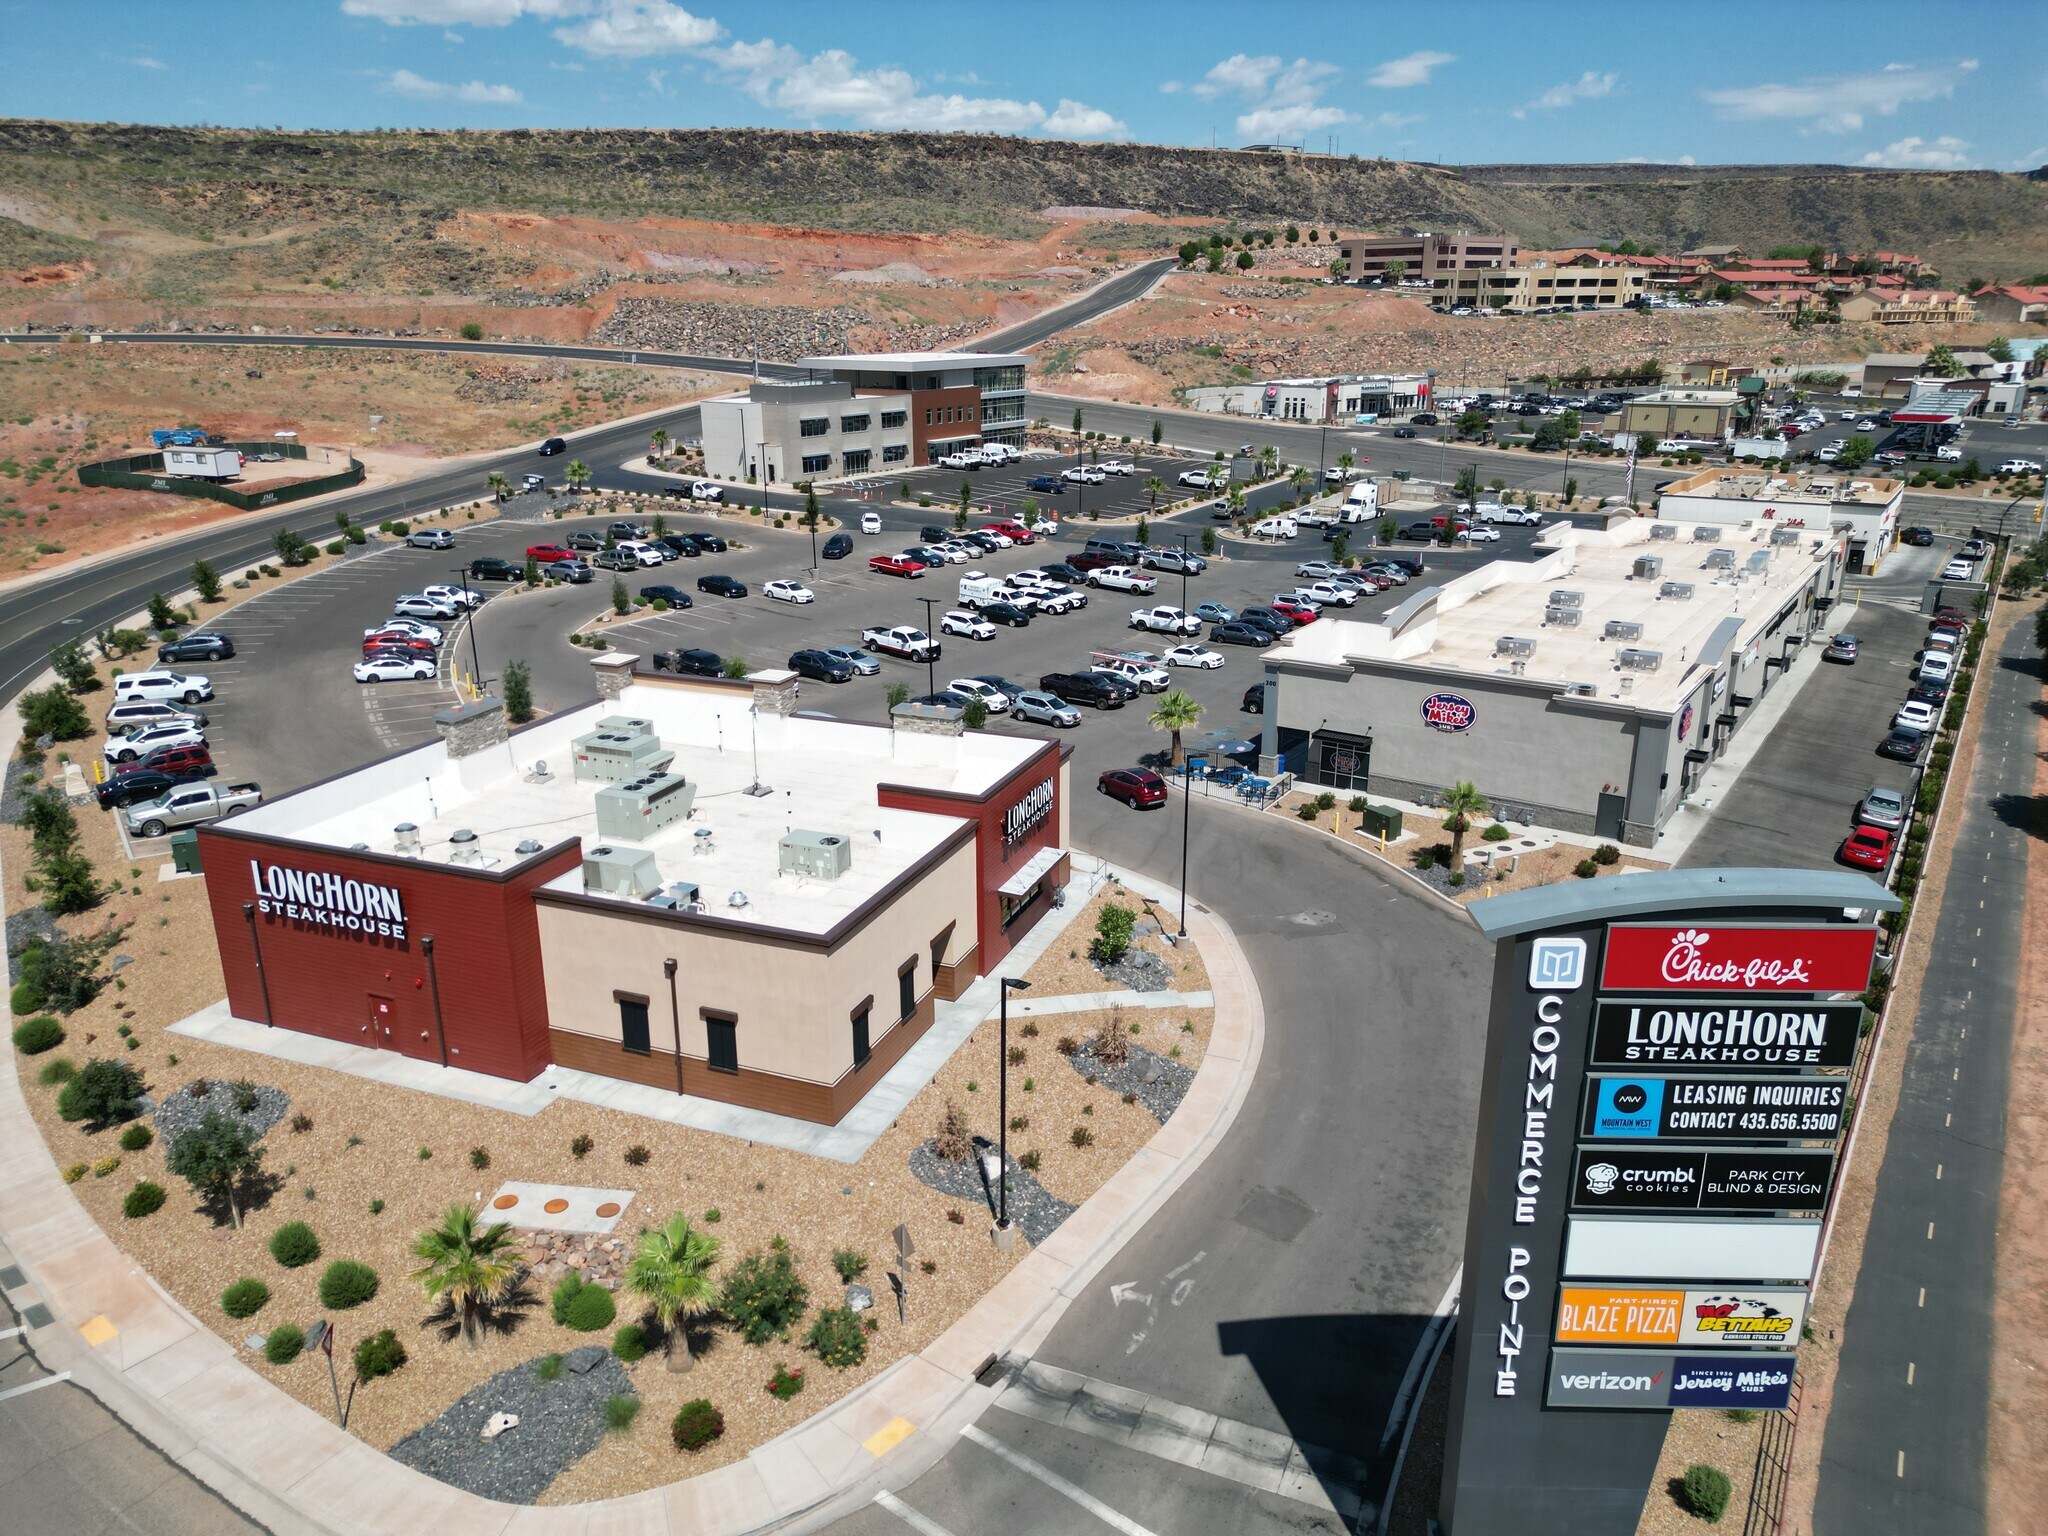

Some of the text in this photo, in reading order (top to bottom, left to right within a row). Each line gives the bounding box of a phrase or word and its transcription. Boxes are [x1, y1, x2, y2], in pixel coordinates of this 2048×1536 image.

[1426, 697, 1471, 717] Jersey
[1427, 709, 1469, 726] Mike's
[1007, 776, 1054, 834] LONGHORN
[1008, 800, 1054, 845] STEAKHOUSE
[250, 860, 403, 922] LONGHORN
[258, 900, 405, 940] STEAKHOUSE
[1662, 930, 1809, 987] Chick-fil-A
[1627, 1008, 1827, 1046] LONGHORN
[1625, 1046, 1821, 1063] STEAKHOUSE
[1673, 1085, 1843, 1107] LEASING INQUIRIES
[1515, 995, 1563, 1223] COMMERCE
[1601, 1118, 1653, 1128] MOUNTAIN WEST
[1669, 1111, 1838, 1131] CONTACT 435.656.5500
[1622, 1166, 1696, 1183] crumbl
[1728, 1170, 1805, 1181] PARK CITY
[1626, 1183, 1689, 1193] cookies
[1707, 1182, 1822, 1194] BLIND & DESIGN
[1561, 1304, 1676, 1334] BLAZE PIZZA
[1696, 1303, 1740, 1318] MO'
[1496, 1247, 1531, 1396] POINTE
[1696, 1316, 1793, 1333] BETTAHS
[1561, 1371, 1652, 1391] verizon
[1674, 1371, 1788, 1392] Jersey Mike's
